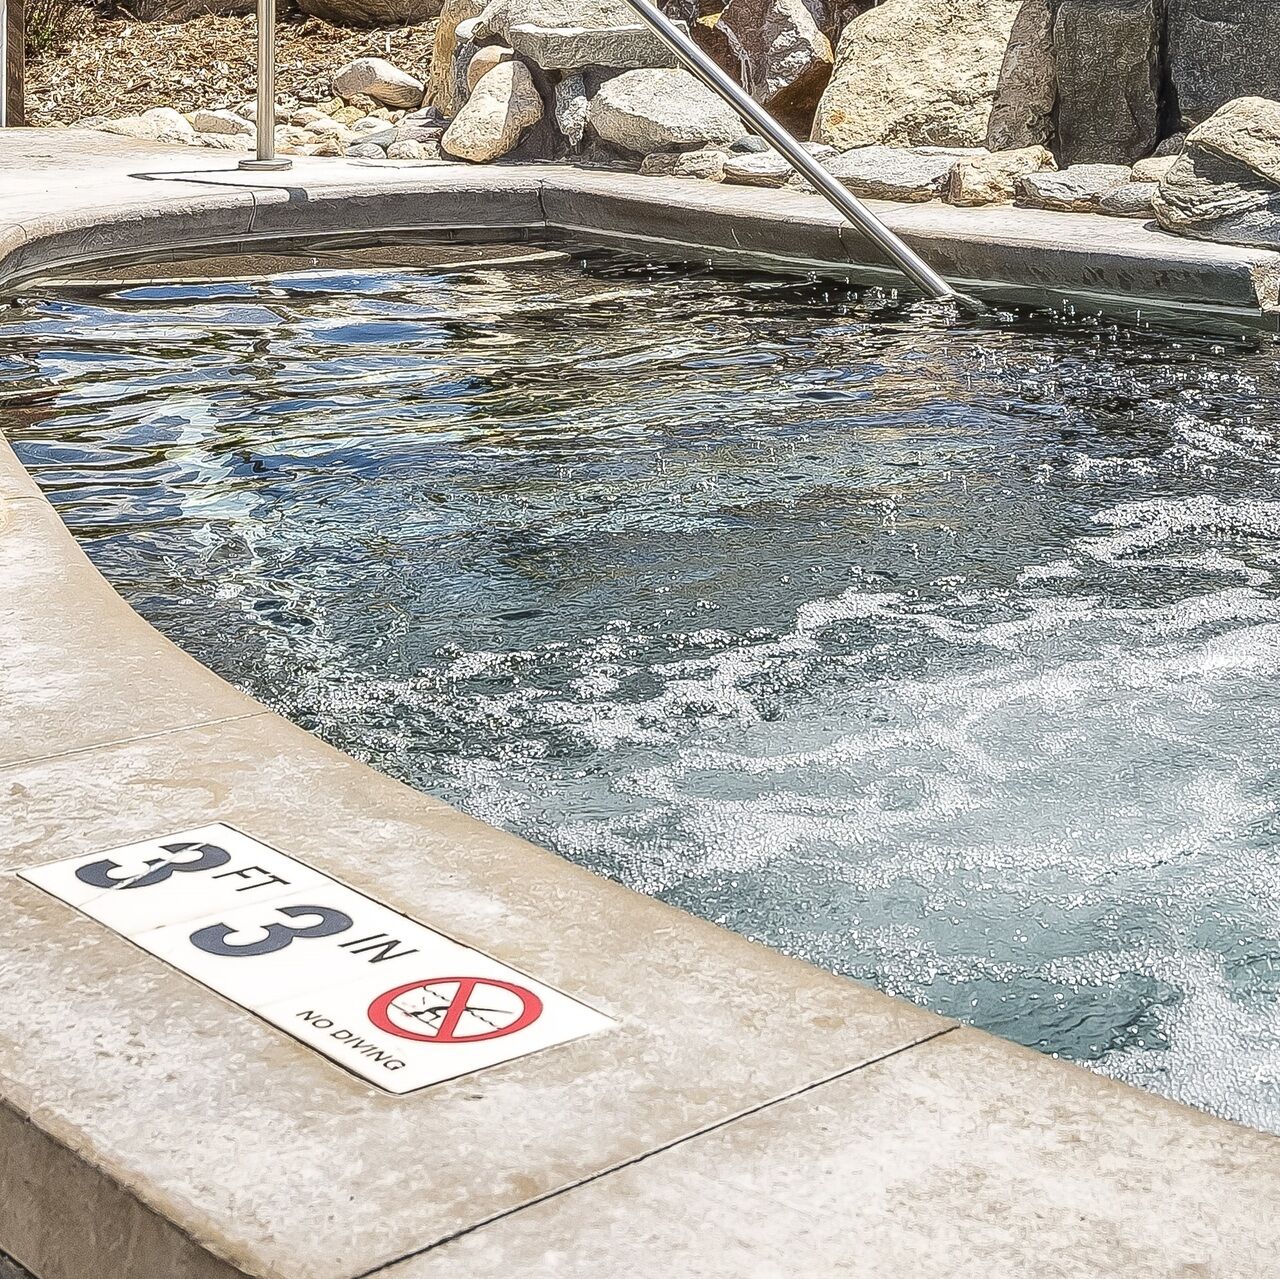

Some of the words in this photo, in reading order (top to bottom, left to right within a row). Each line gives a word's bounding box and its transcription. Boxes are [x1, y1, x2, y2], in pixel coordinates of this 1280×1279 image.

[74, 841, 232, 890] 3
[212, 865, 291, 892] FT
[188, 904, 354, 958] 3
[337, 933, 419, 964] IN
[296, 1010, 334, 1029] NO
[331, 1028, 406, 1072] DIVING
